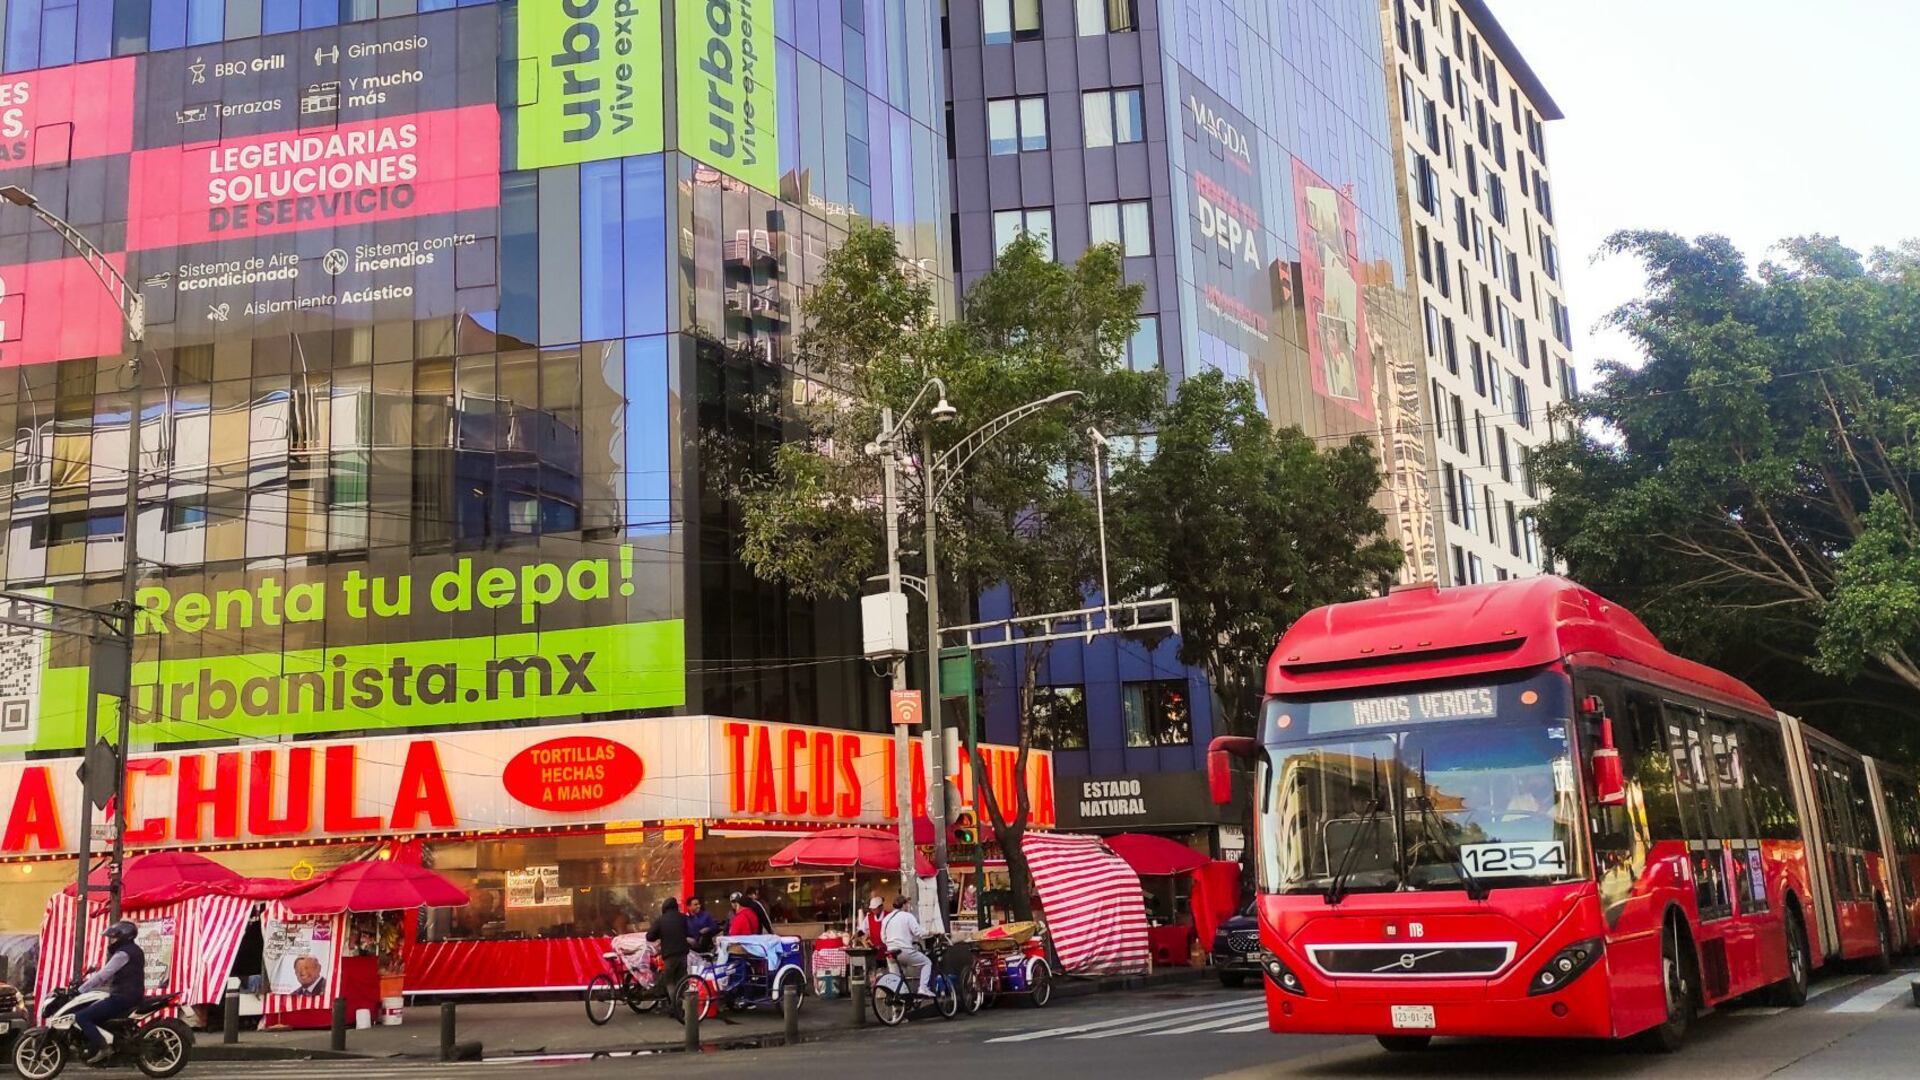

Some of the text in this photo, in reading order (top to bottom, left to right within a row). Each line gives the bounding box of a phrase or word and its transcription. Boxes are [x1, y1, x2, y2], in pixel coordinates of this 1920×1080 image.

[348, 35, 428, 59] Gimnasio
[215, 54, 285, 78] BBQ Grill
[349, 69, 424, 91] Y mucho
[214, 97, 282, 118] Terrazas
[348, 90, 387, 108] más
[609, 63, 633, 134] Vive
[740, 101, 757, 166] Vive
[1190, 95, 1252, 163] MAGDA
[210, 124, 418, 174] LEGENDARIAS
[209, 154, 418, 204] SOLUCIONES
[208, 183, 416, 232] DE SERVICIO
[355, 232, 477, 261] Sistema contra
[1198, 195, 1260, 271] DEPA
[179, 252, 299, 277] Sistema de Aire
[355, 250, 435, 273] incendios
[178, 265, 299, 291] acondicionado
[243, 282, 414, 316] Aislamiento Acústico
[135, 543, 634, 634] Renta tu depa!
[131, 651, 597, 724] urbanista.mx
[1353, 688, 1494, 725] INDIOS VERDES
[530, 744, 616, 765] TORTILLAS
[541, 764, 605, 783] HECHAS
[723, 722, 862, 818] TACOS
[105, 740, 456, 845] CHULA
[542, 784, 604, 802] A MANO
[1083, 780, 1141, 798] ESTADO
[1080, 799, 1146, 817] NATURAL
[1466, 846, 1564, 873] 1254
